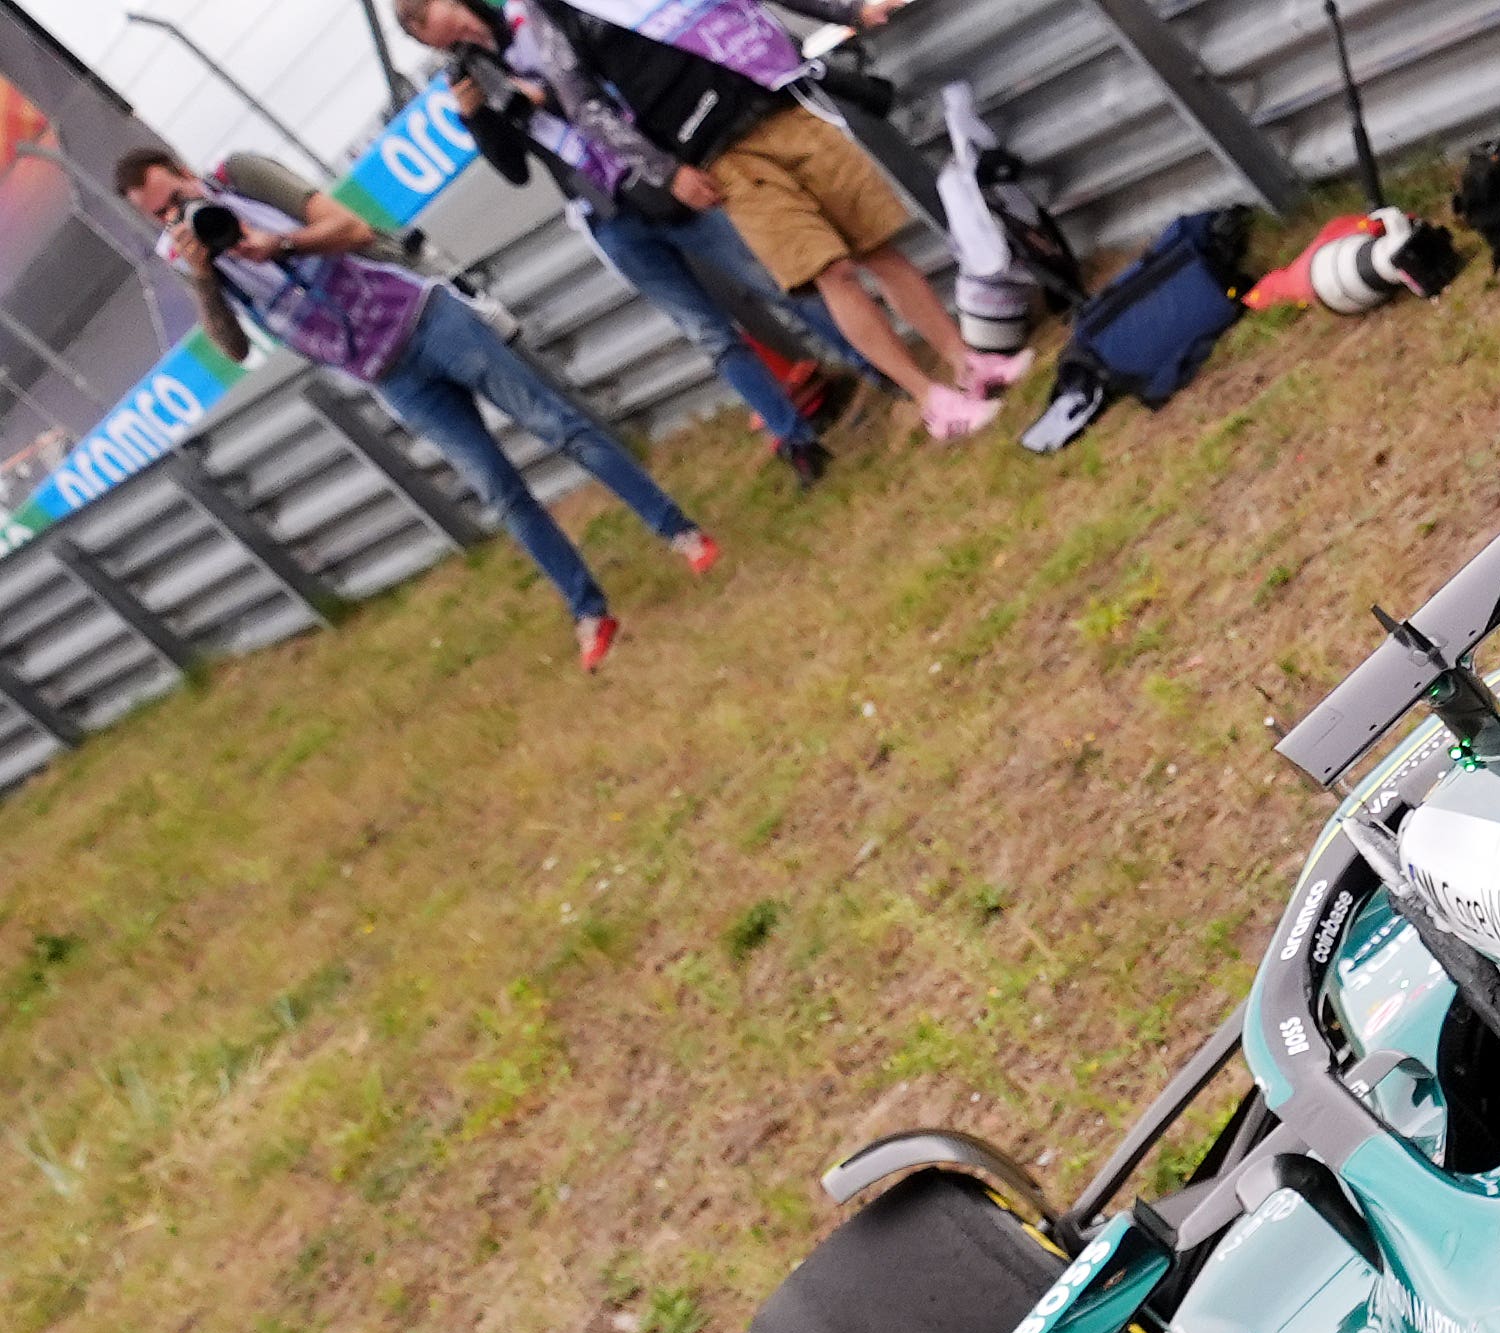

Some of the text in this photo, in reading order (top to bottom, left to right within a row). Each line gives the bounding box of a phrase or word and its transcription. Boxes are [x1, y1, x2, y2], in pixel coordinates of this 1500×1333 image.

[54, 374, 201, 508] aramco
[1281, 879, 1327, 961] aramco
[1312, 890, 1354, 964] coinbase
[1279, 1016, 1310, 1057] BOSS
